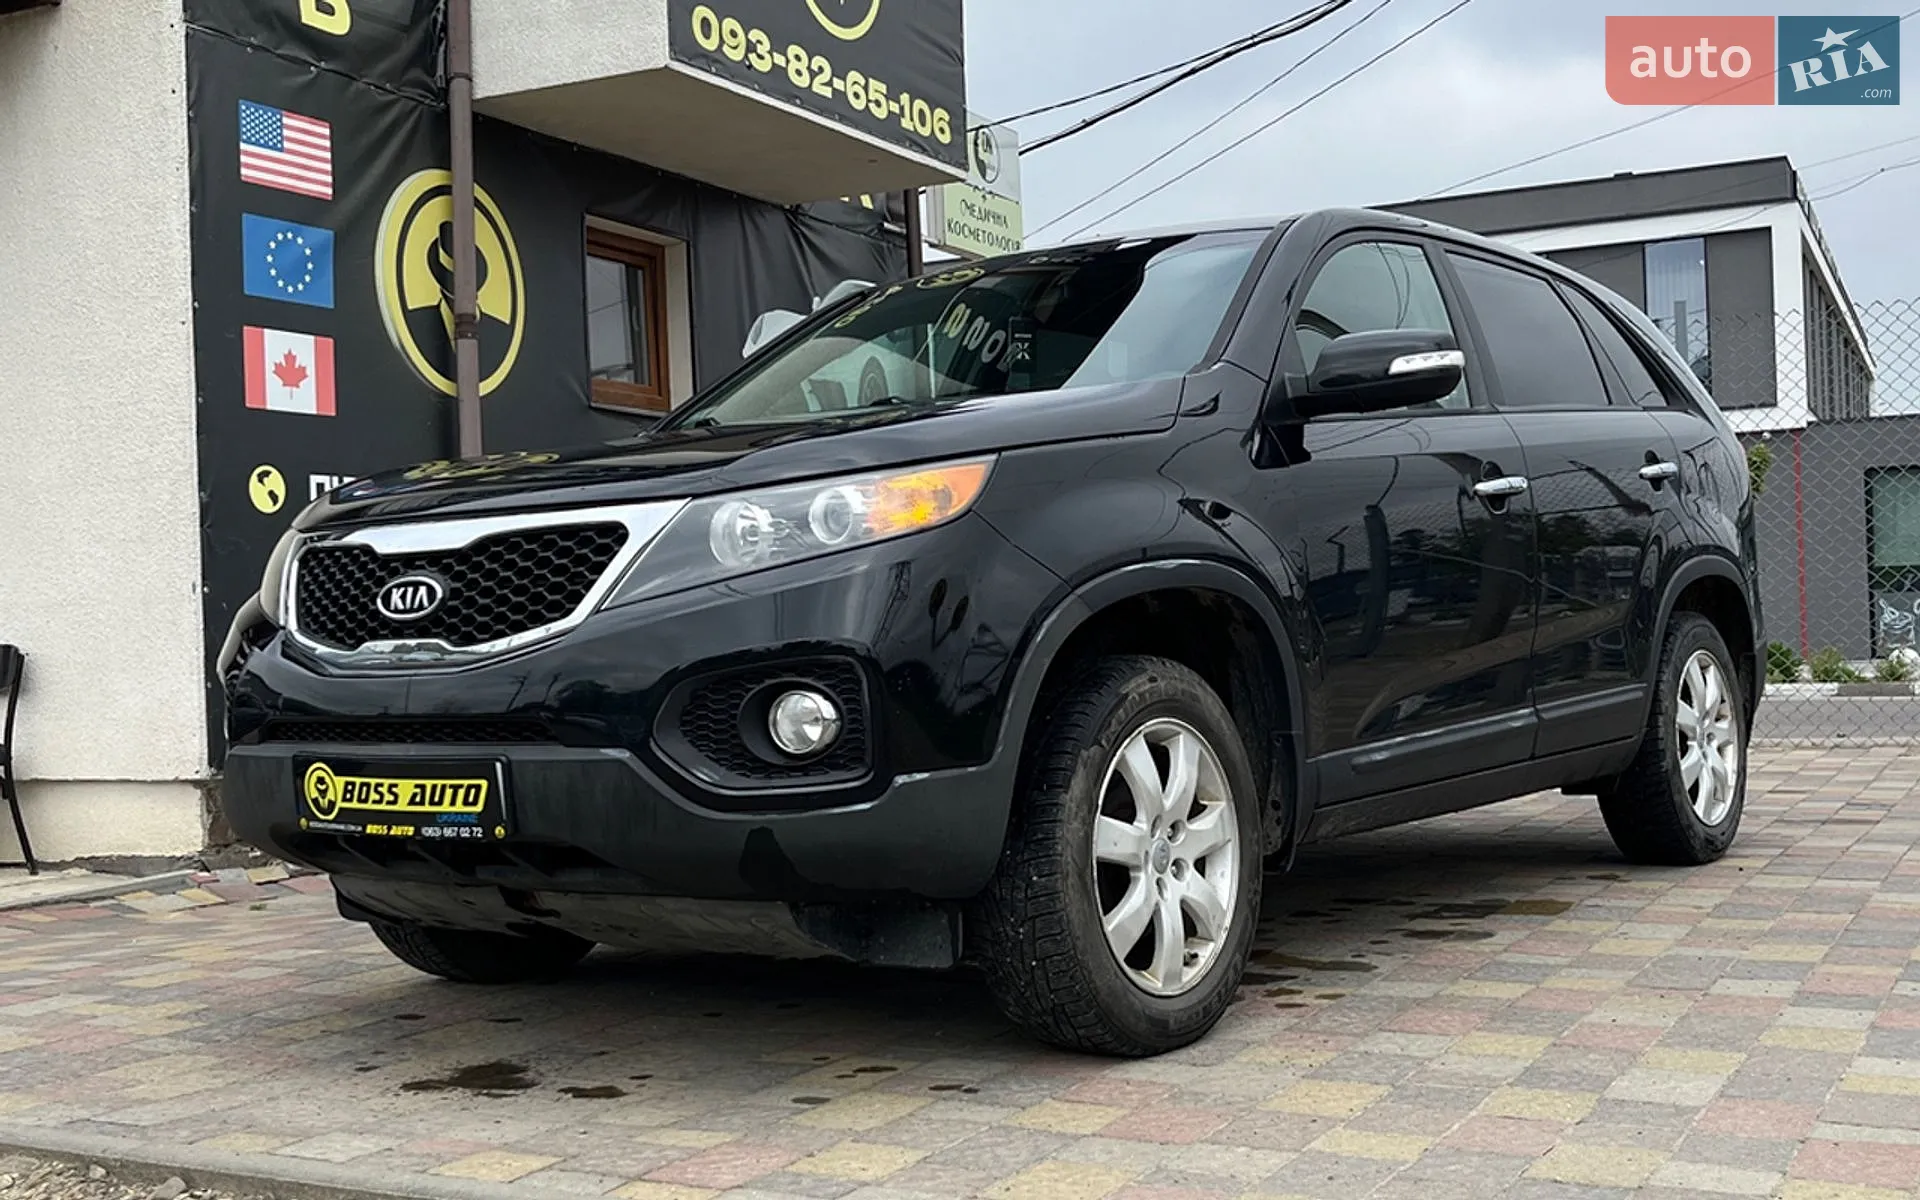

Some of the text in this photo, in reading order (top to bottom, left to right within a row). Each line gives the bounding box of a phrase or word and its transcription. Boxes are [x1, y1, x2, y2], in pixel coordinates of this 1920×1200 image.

[691, 4, 952, 145] 093-82-65-106
[390, 585, 429, 611] KIA
[341, 780, 483, 807] BOSS AUTO
[365, 824, 388, 835] BOSS
[388, 824, 415, 836] AUTO
